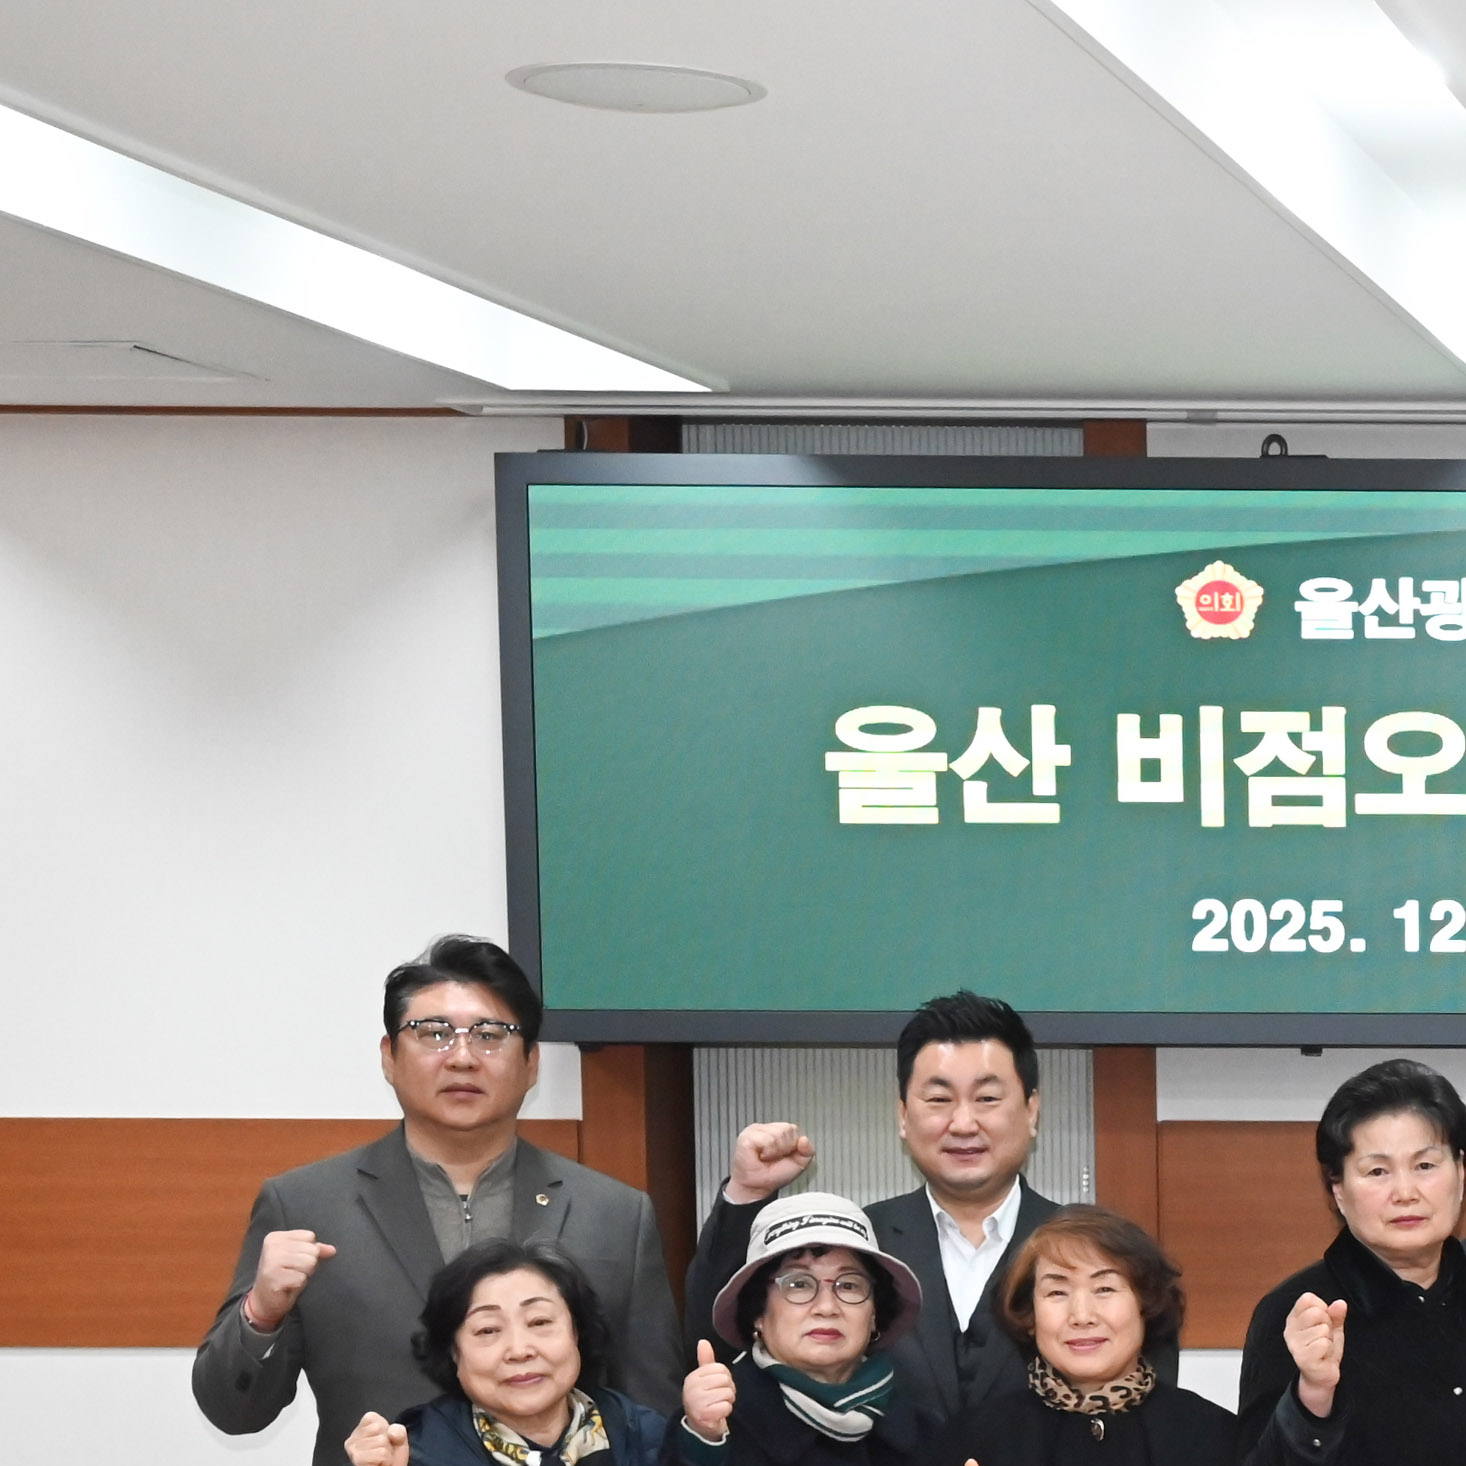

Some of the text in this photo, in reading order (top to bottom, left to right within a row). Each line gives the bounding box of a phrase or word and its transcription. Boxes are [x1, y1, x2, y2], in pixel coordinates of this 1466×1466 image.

[1198, 591, 1241, 613] 의회
[825, 705, 1071, 824] 울산
[1192, 899, 1365, 952] 2025.
